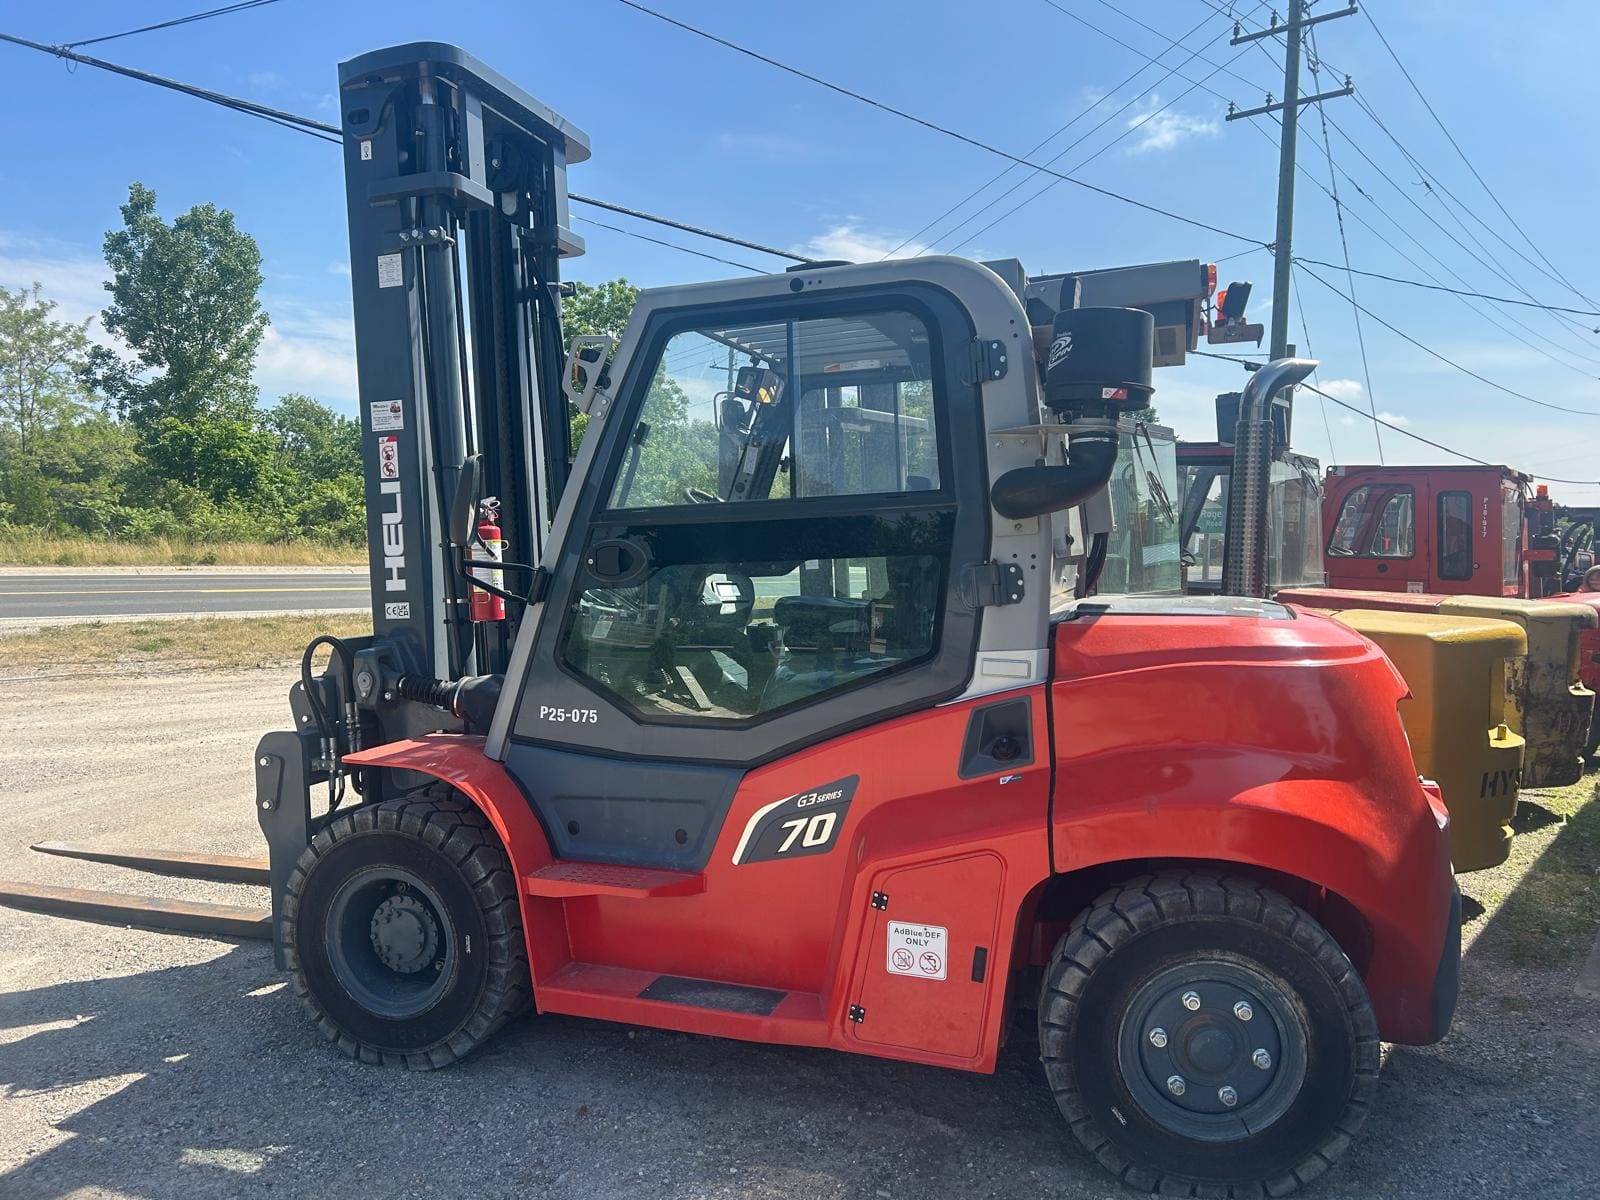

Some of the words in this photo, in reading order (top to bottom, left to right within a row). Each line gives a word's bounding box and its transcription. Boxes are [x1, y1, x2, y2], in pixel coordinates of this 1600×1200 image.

[1200, 510, 1223, 520] Roge
[380, 481, 407, 592] HELI
[540, 705, 598, 724] P25-075
[797, 793, 818, 808] G3
[816, 790, 843, 803] SERIES
[778, 812, 837, 853] 70
[905, 937, 929, 947] ONLY
